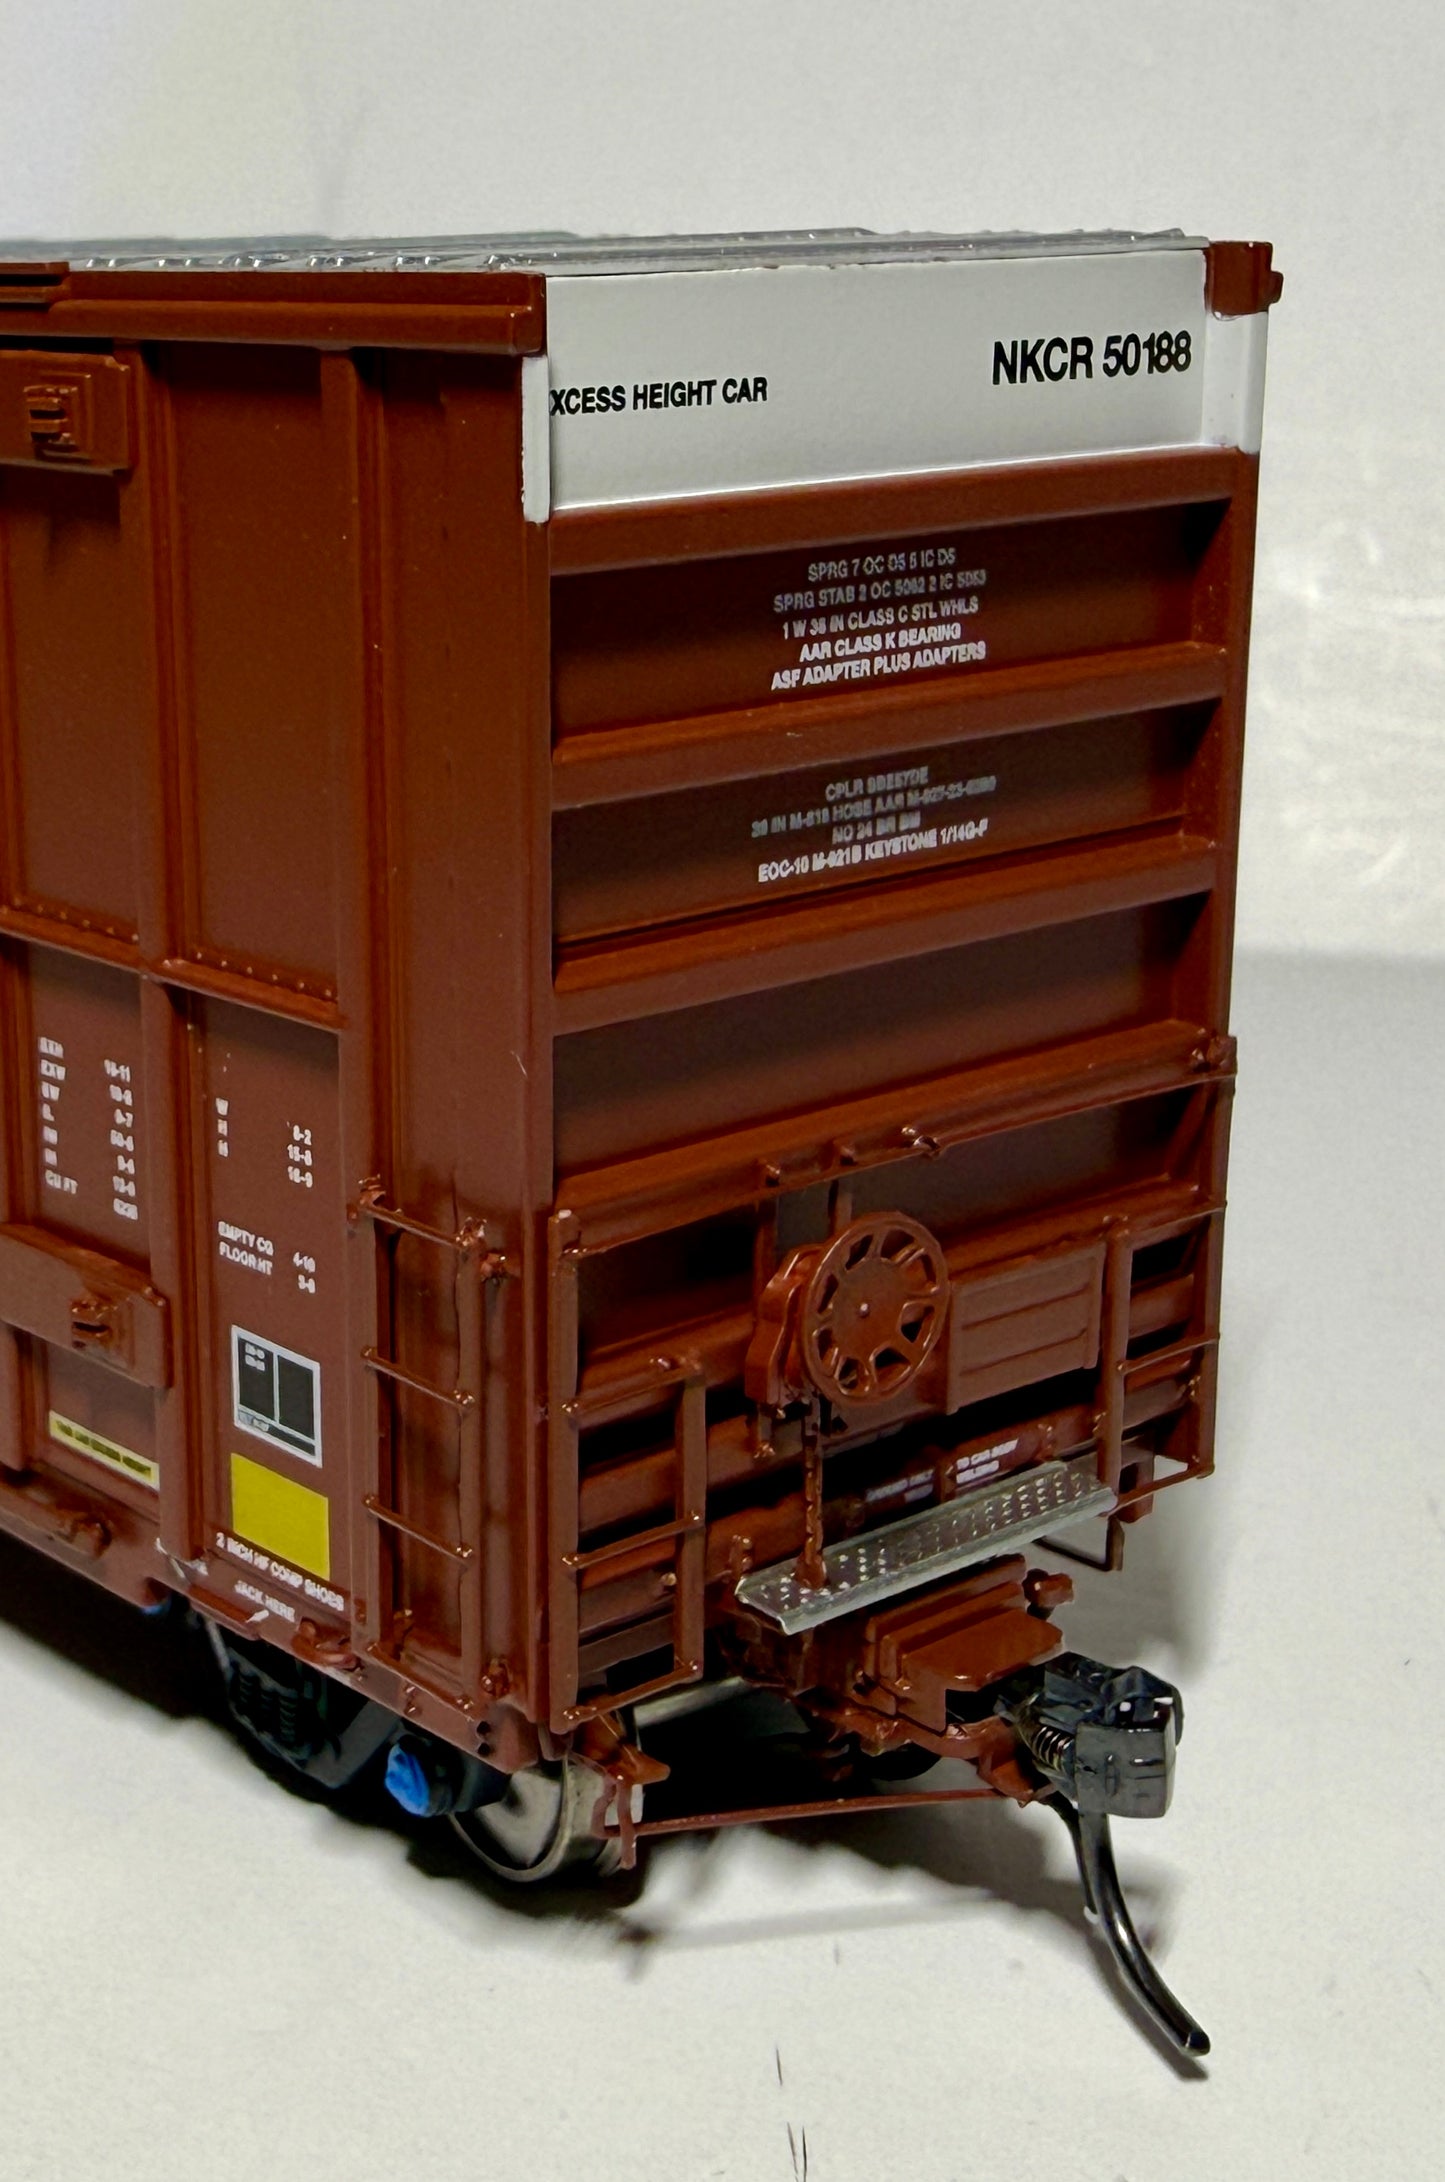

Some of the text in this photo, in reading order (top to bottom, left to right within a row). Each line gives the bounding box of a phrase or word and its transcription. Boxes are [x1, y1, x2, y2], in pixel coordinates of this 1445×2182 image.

[992, 331, 1192, 385] NKCR 50188
[633, 380, 717, 410] HEIGHT
[722, 377, 768, 403] CAR
[808, 559, 847, 582] SPRG
[852, 558, 860, 576] 7
[863, 555, 884, 575] OC
[920, 549, 934, 568] IC
[774, 591, 815, 613] SPRG
[818, 585, 855, 607] STAB
[870, 580, 891, 600] OC
[939, 572, 954, 591] IC
[783, 624, 789, 640] 1
[792, 619, 806, 638] W
[829, 614, 845, 633] IN
[847, 608, 894, 631] CLASS
[898, 605, 908, 622] C
[911, 602, 937, 621] STL
[939, 596, 979, 617] WHLS
[799, 622, 961, 662] AAR CLASS K BEARING
[771, 641, 986, 690] ASF ADAPTER PLUS ADAPTERS
[825, 777, 864, 801] CPLR
[758, 854, 809, 883] EOC-10
[864, 828, 937, 861] KEYSTONE
[218, 1221, 255, 1247] EMPTY
[219, 1241, 257, 1269] FLOOR
[216, 1532, 225, 1549] 2
